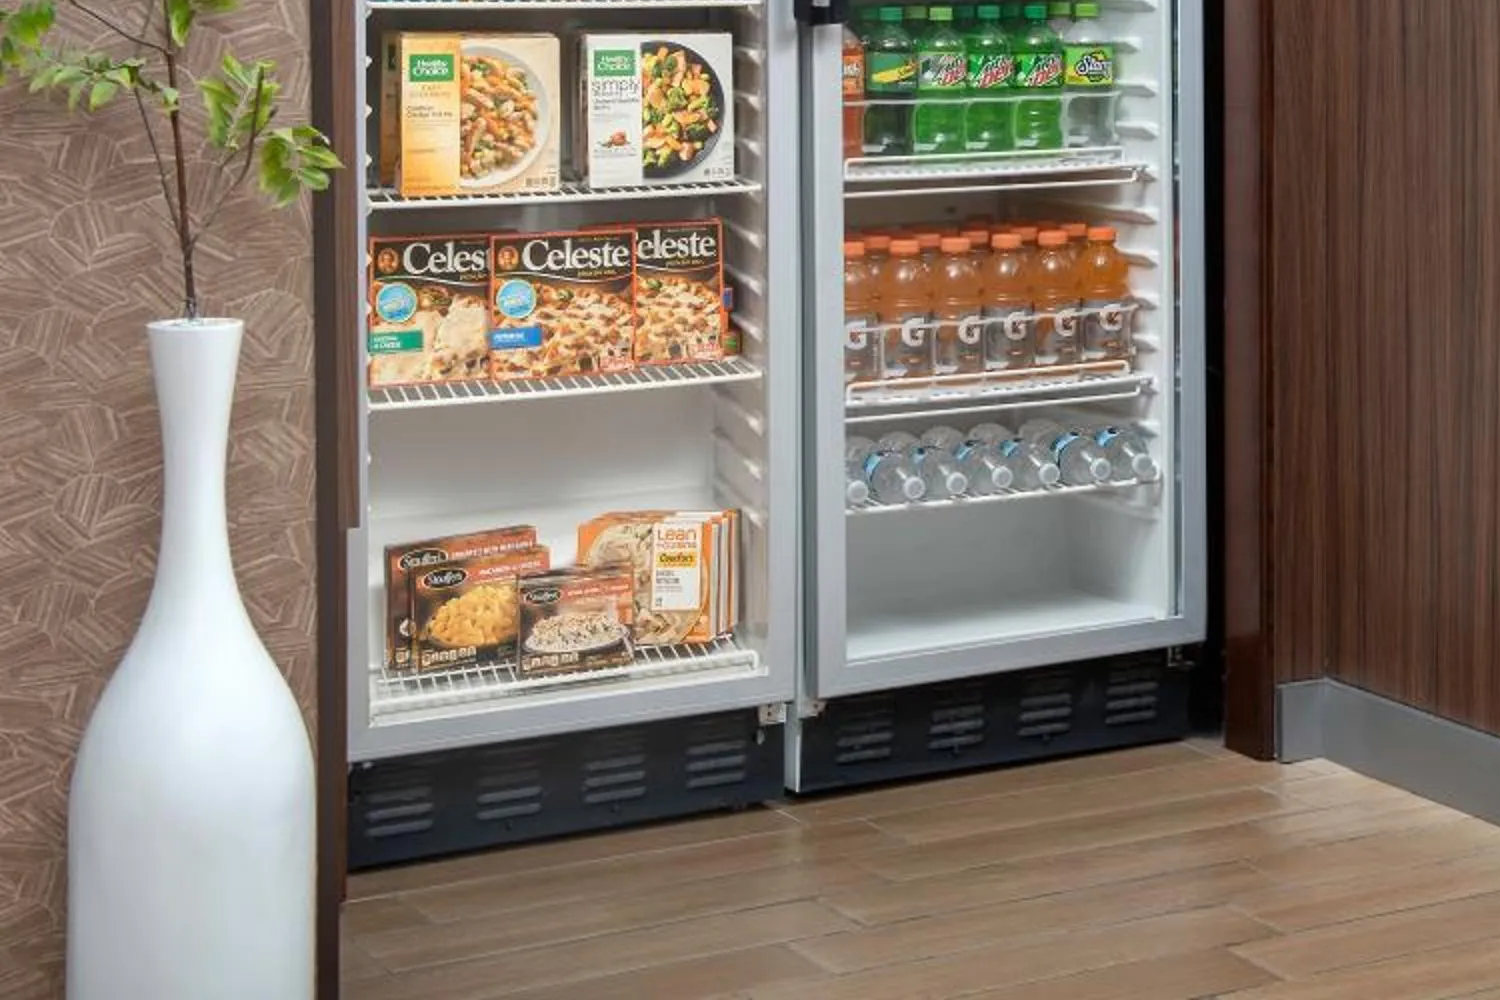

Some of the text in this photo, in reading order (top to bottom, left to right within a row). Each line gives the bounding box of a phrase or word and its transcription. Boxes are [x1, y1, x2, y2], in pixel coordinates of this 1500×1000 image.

[403, 242, 491, 274] Celes
[521, 238, 631, 272] Celeste
[635, 229, 717, 259] eleste
[958, 315, 982, 345] G
[1004, 311, 1026, 340] G
[1054, 307, 1077, 336] G
